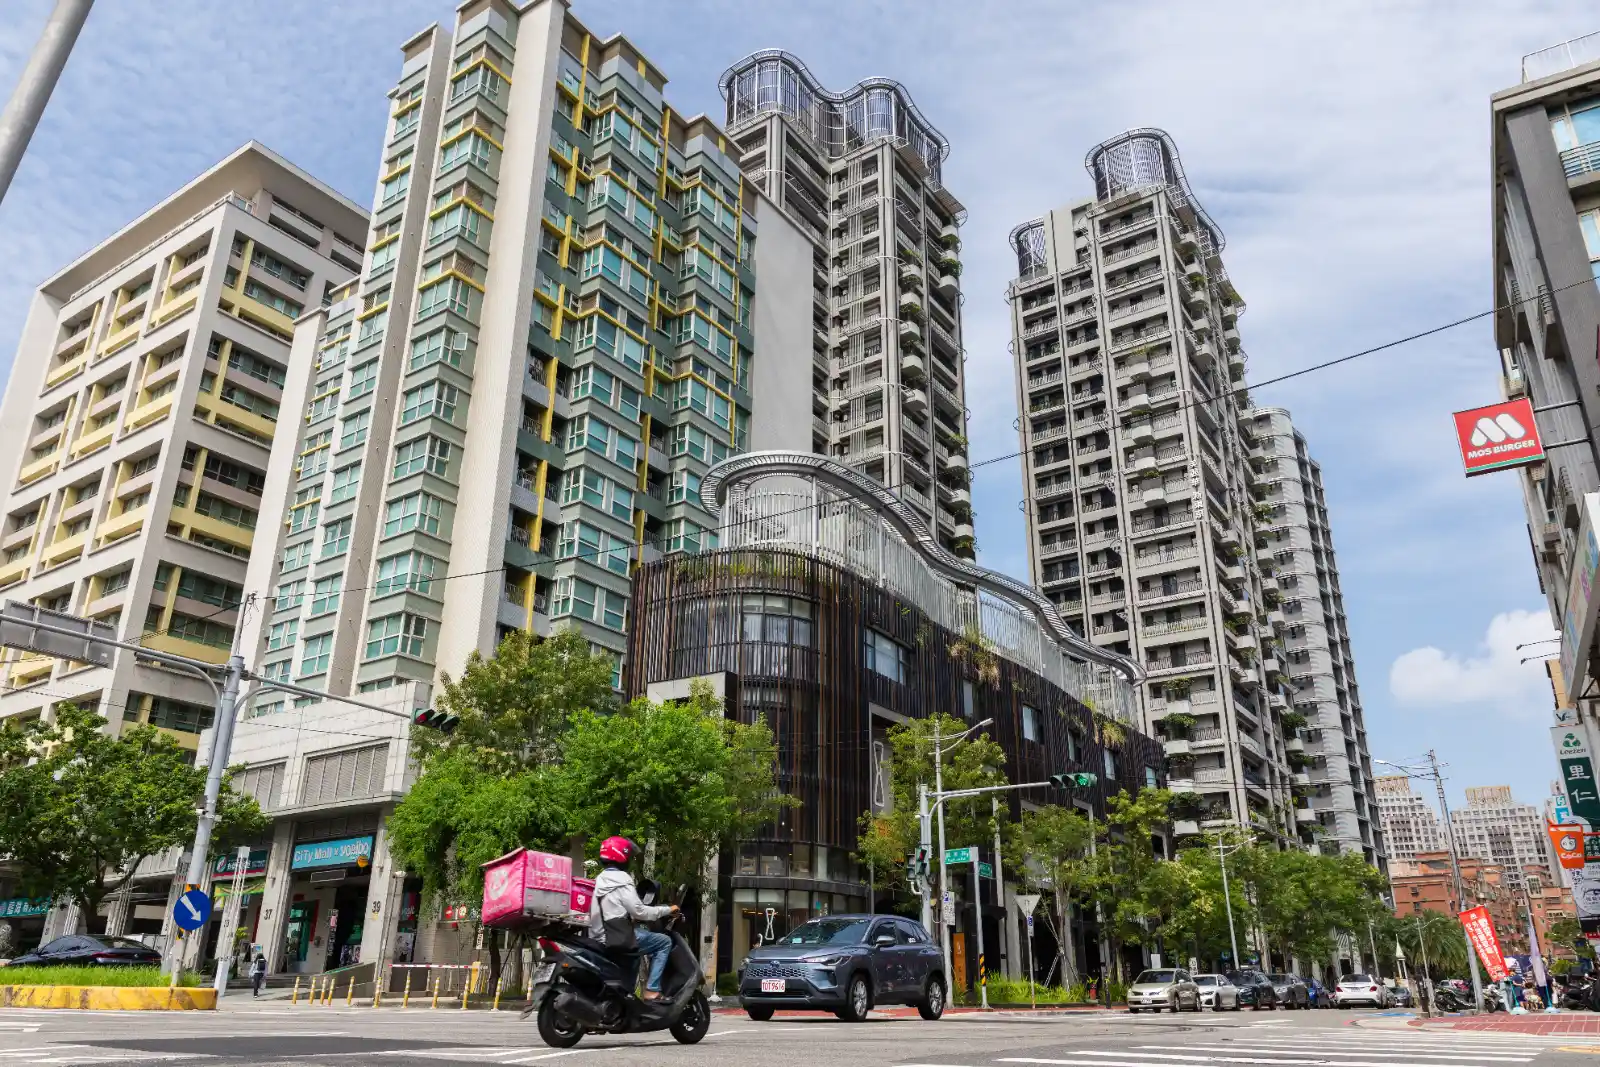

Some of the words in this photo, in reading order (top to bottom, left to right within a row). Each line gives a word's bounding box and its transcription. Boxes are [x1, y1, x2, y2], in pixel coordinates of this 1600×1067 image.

[1468, 447, 1492, 459] MOS
[1493, 439, 1536, 454] BURGER
[1560, 747, 1586, 755] Leezen
[1567, 764, 1596, 804] 里仁
[314, 846, 333, 860] Mall
[371, 900, 381, 913] 39
[263, 908, 273, 920] 37
